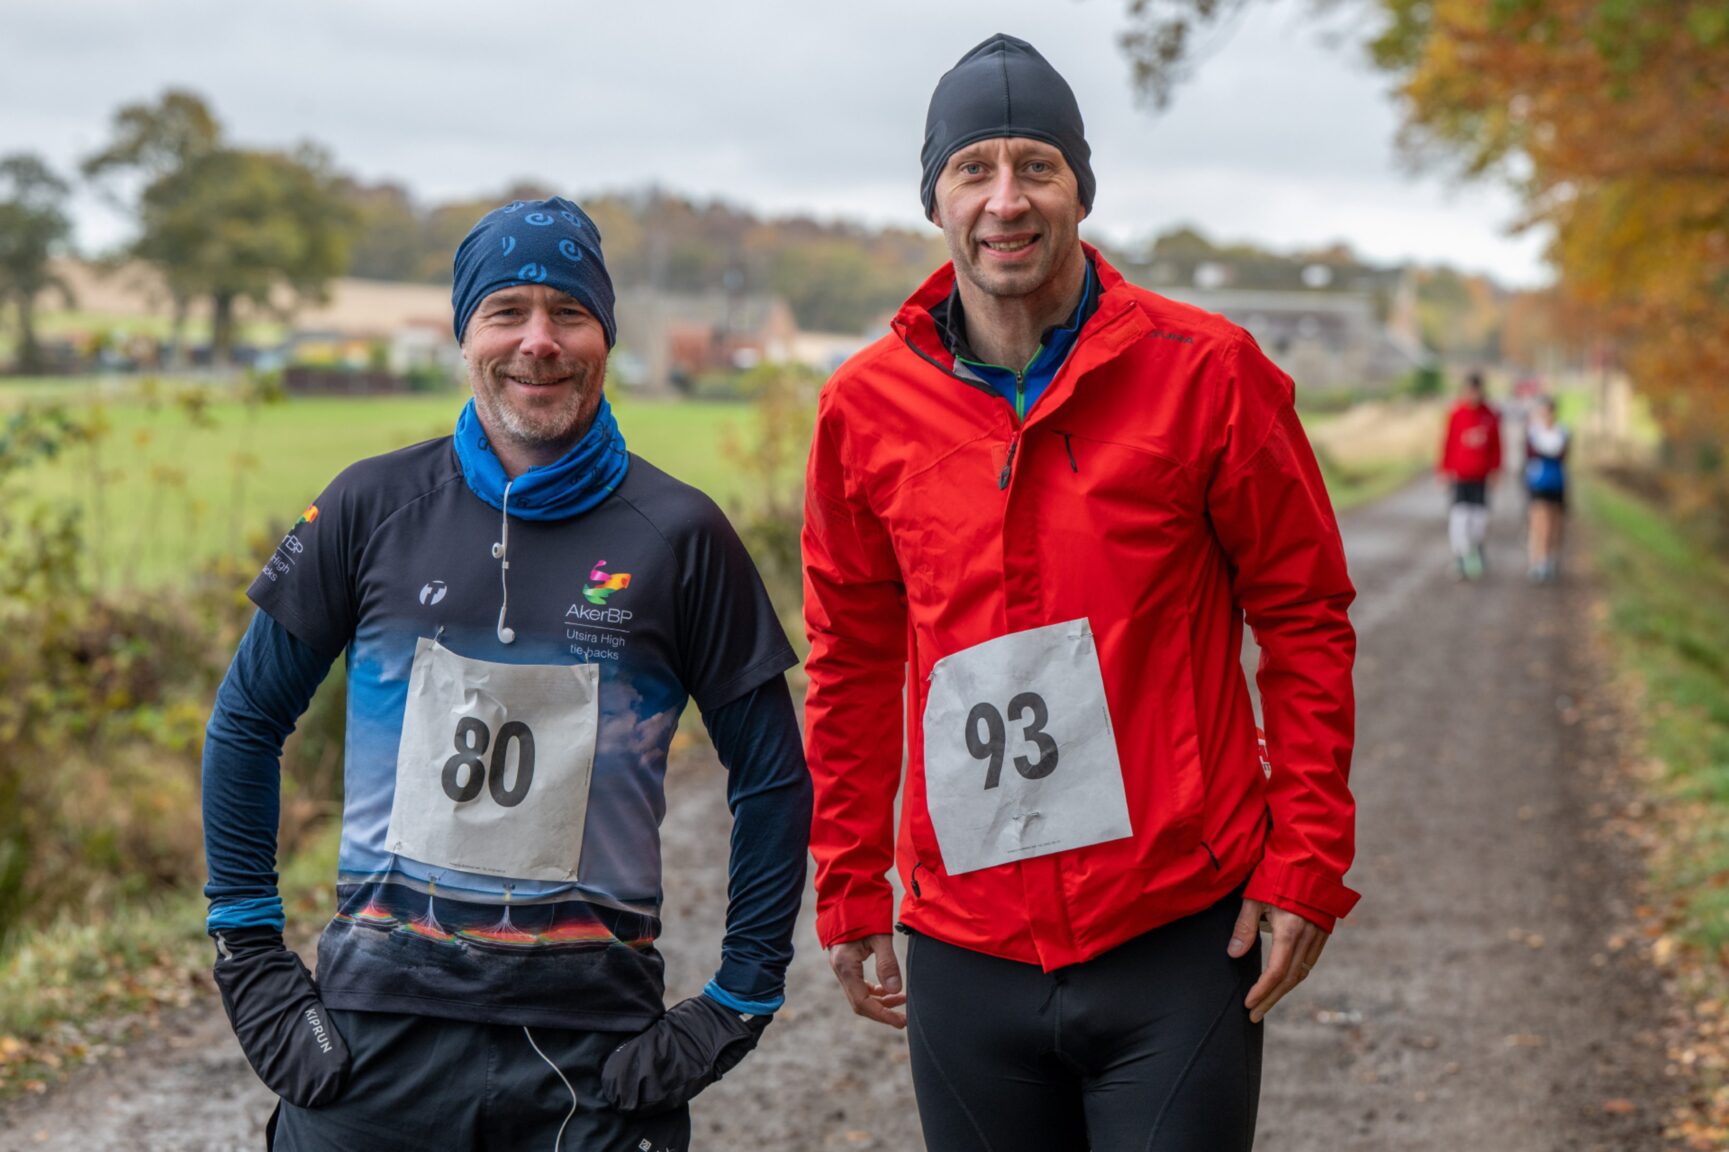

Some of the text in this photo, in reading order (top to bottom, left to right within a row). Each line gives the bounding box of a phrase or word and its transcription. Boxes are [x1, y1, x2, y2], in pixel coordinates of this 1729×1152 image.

[565, 603, 633, 624] AkerBP
[566, 628, 626, 648] Utsira High
[441, 716, 536, 807] 80
[965, 691, 1059, 791] 93
[304, 1008, 333, 1054] KIPRUN
